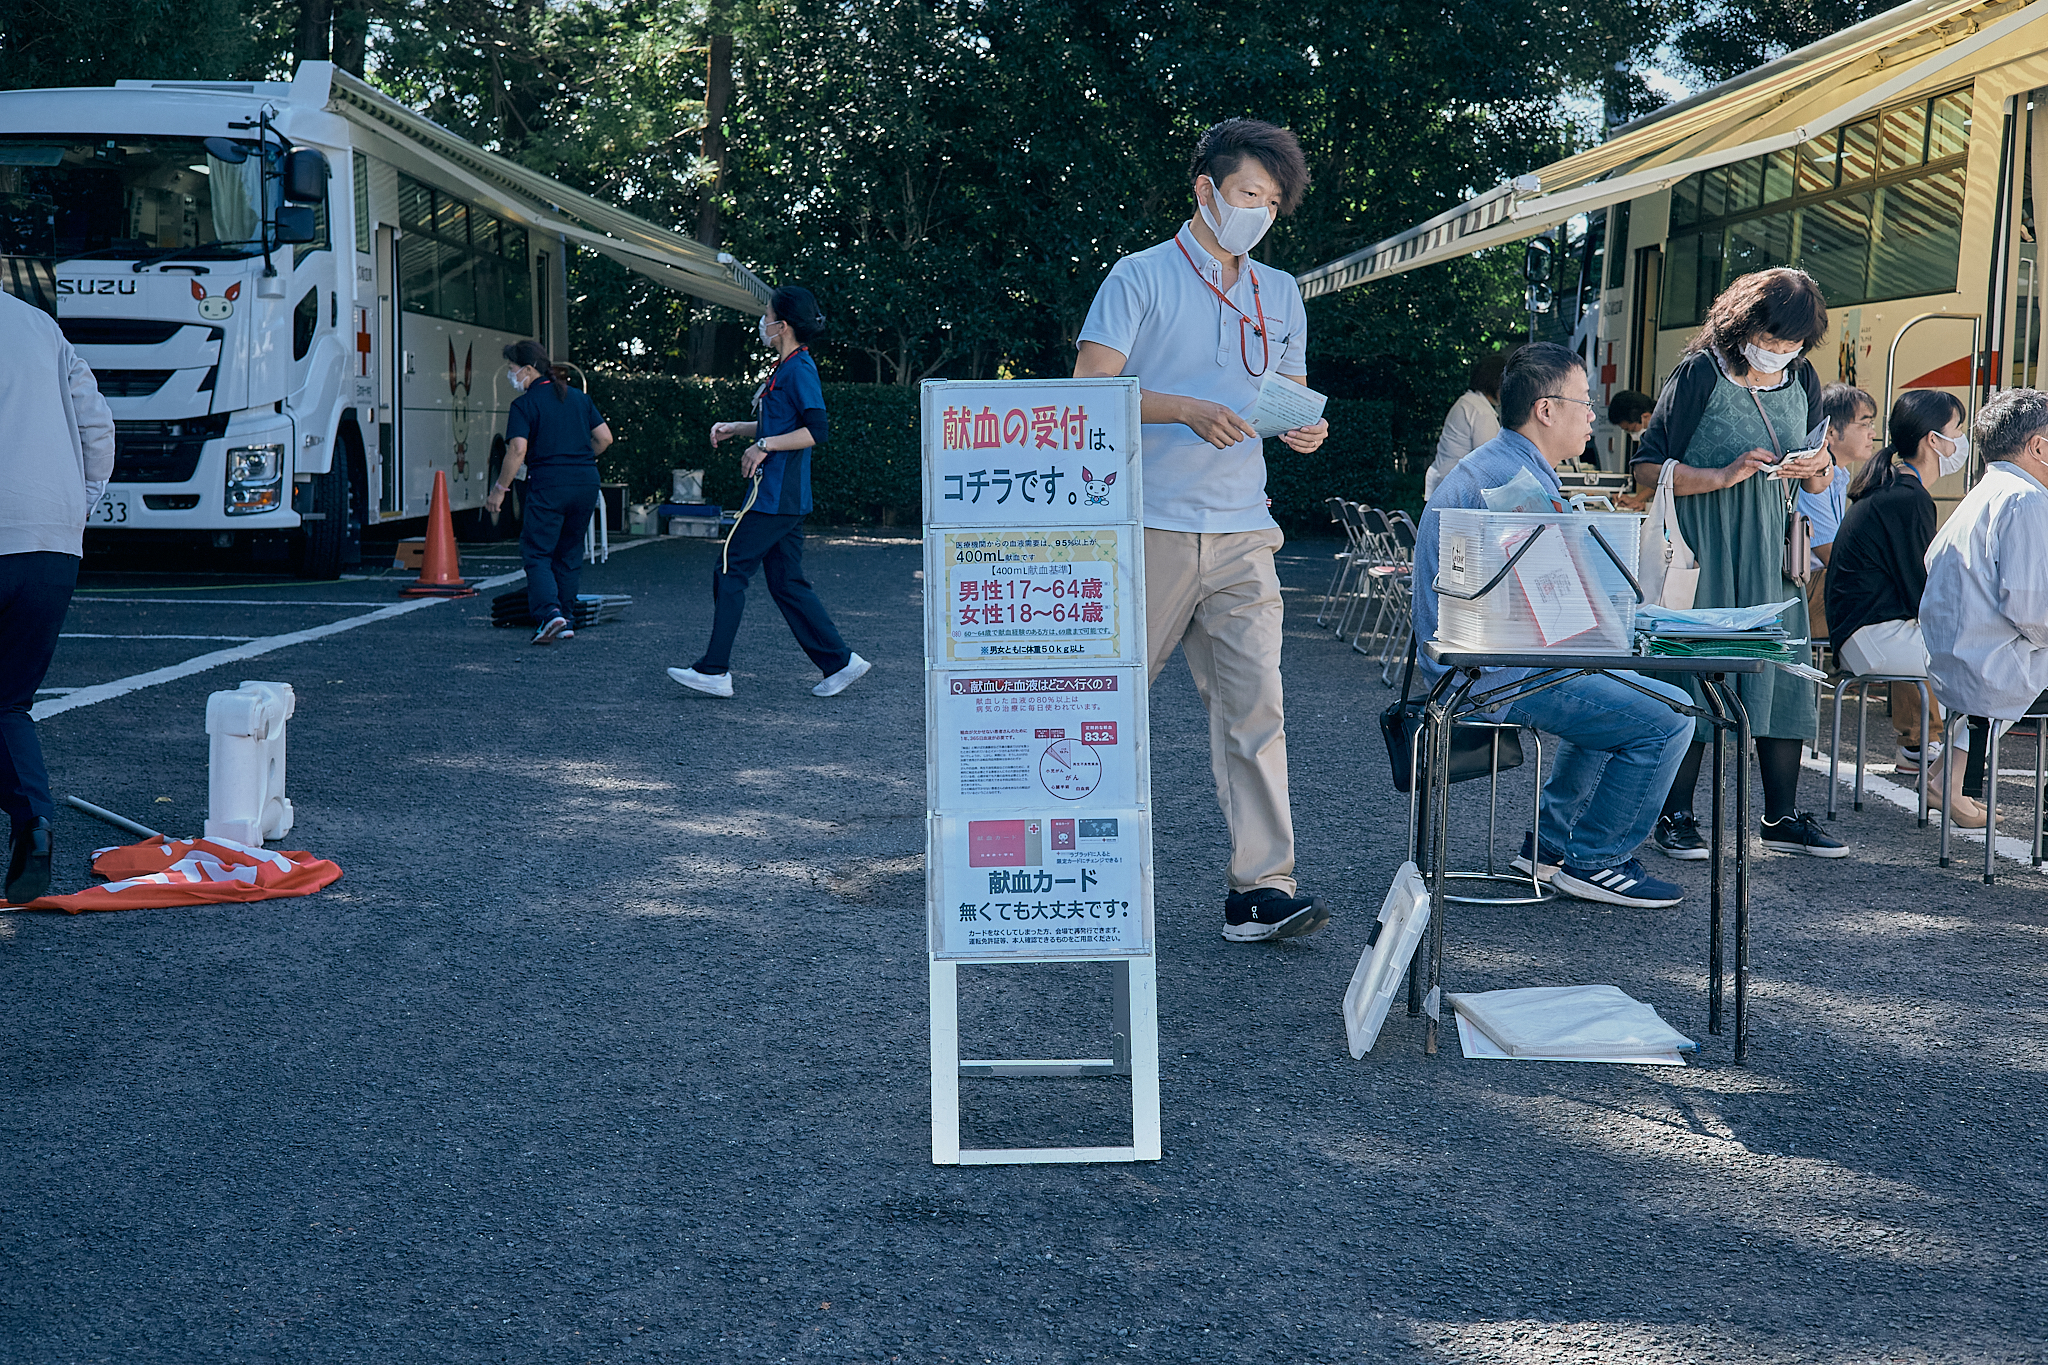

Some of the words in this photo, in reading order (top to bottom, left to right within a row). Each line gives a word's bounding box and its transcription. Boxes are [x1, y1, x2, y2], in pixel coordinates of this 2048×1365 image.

[57, 280, 138, 295] SUZU
[943, 405, 1114, 451] 献血の受付は、
[944, 466, 1077, 505] コチラです。
[87, 502, 127, 522] -33
[1084, 731, 1115, 742] 83.2%
[988, 868, 1098, 895] 献血カード
